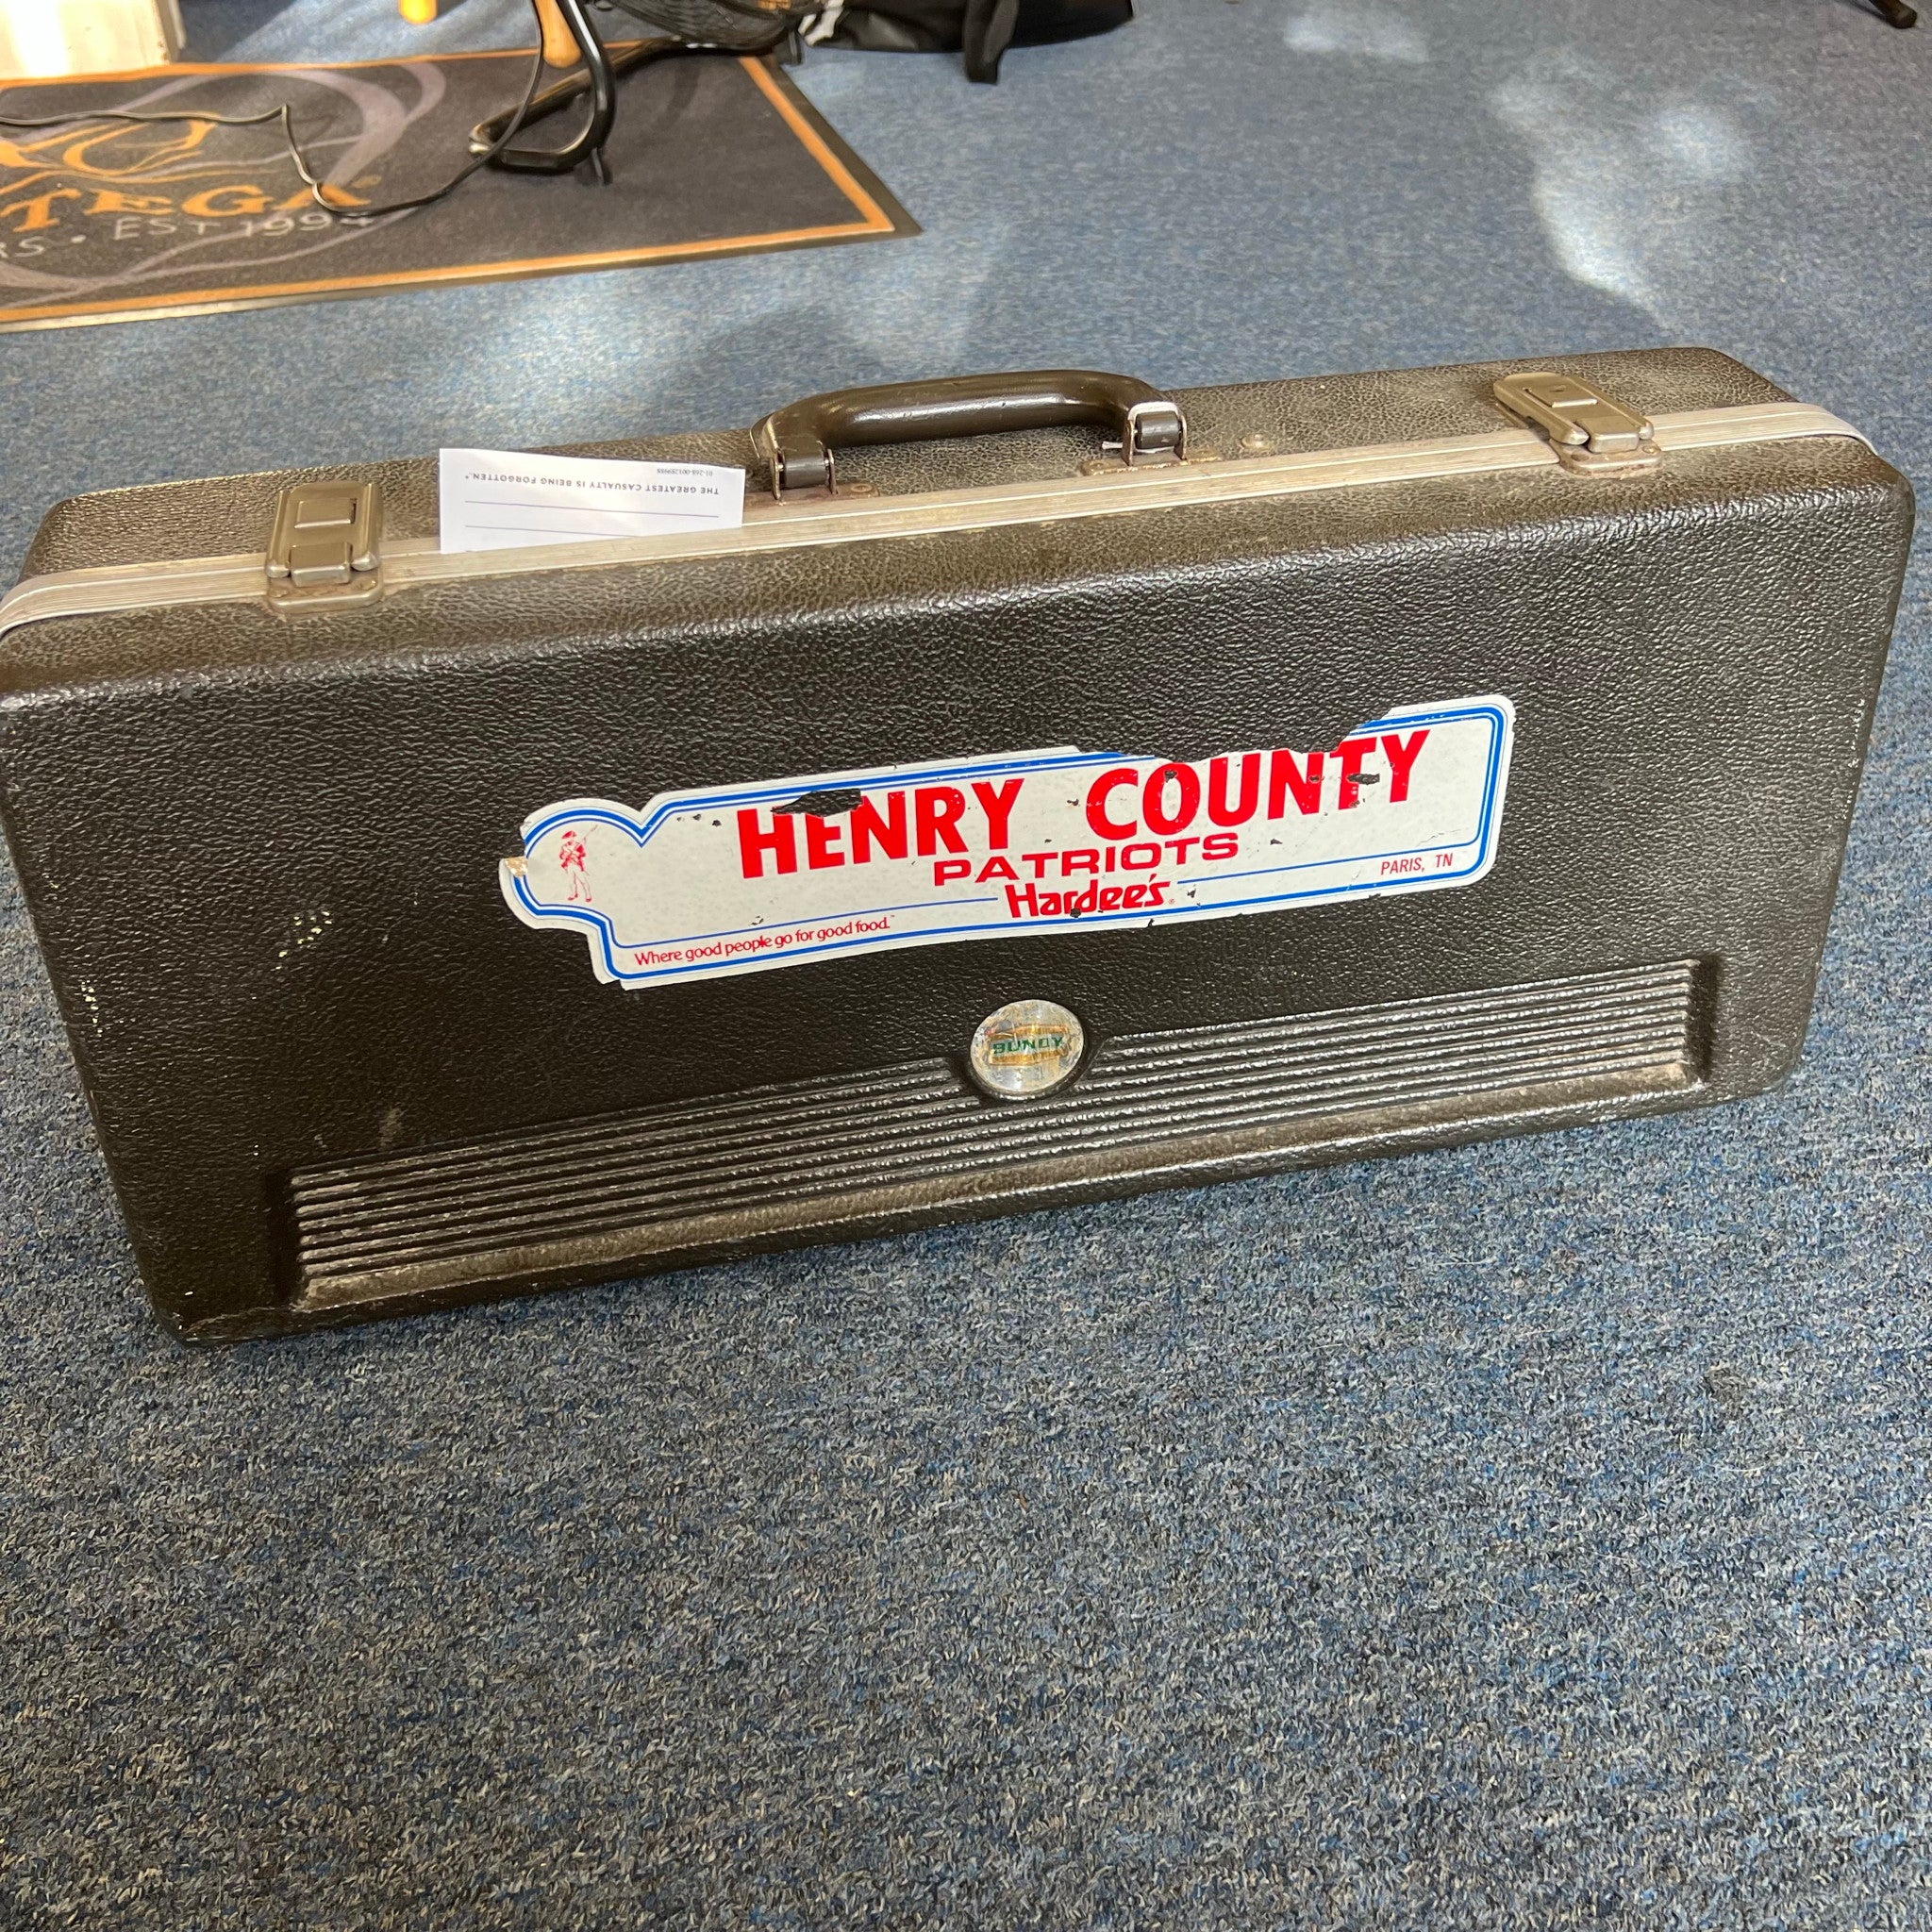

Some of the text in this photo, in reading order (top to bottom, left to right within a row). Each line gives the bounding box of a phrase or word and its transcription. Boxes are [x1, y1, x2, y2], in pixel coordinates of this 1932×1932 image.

[113, 215, 221, 241] EST
[540, 477, 573, 487] BEING
[575, 479, 586, 488] IS
[589, 481, 642, 491] CASUALTY
[645, 484, 697, 493] GREATEST
[700, 486, 719, 495] THE
[737, 729, 1431, 879] HENRY COUNTY
[934, 831, 1239, 887] PATRIOTS
[1380, 852, 1454, 875] PARIS, TN
[1005, 873, 1171, 918] Hardee's
[634, 916, 891, 966] Where good people go for good food.
